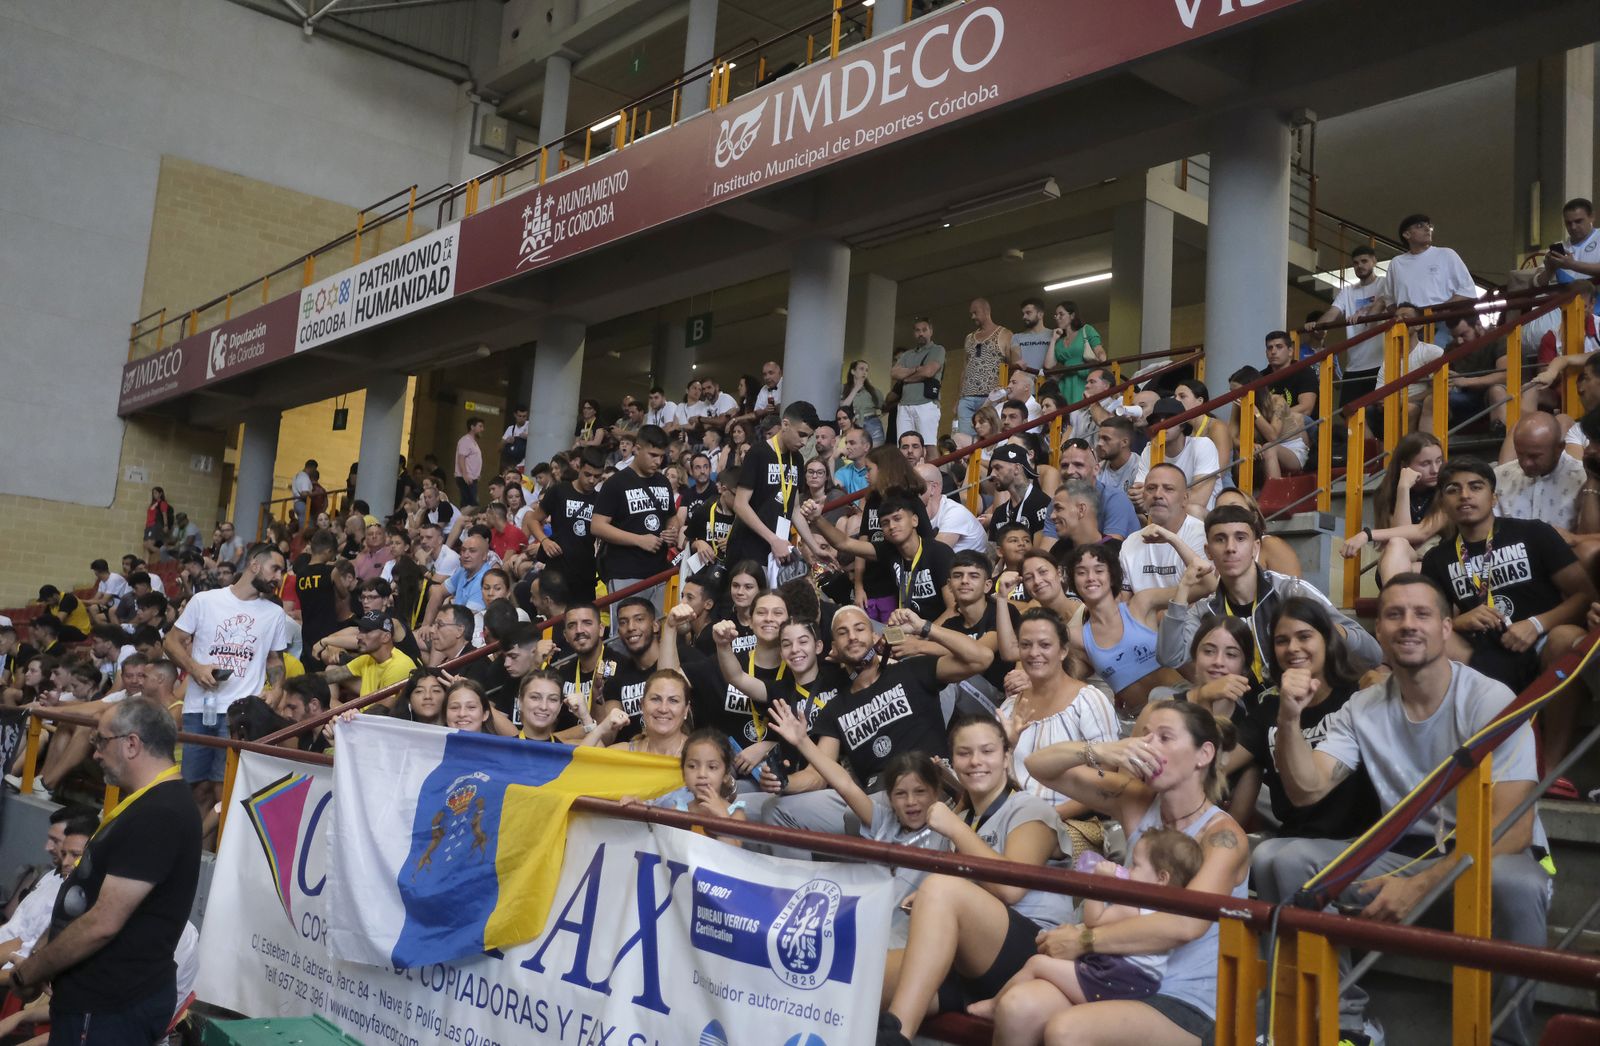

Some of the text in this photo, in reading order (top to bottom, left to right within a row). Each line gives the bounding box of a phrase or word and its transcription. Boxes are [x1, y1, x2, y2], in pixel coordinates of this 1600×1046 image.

[770, 5, 1005, 147] IMDECO
[712, 84, 999, 197] Instituto Municipal de Deportes Córdoba
[555, 168, 629, 217] AYUNTAMIENTO
[553, 201, 615, 243] DE CÓRDOBA
[357, 235, 454, 295] PATRIMONIO DE LA
[354, 265, 451, 325] HUMANIDAD
[229, 321, 267, 350] Diputación
[299, 311, 346, 345] CÓRDOBA
[692, 319, 704, 341] B
[134, 348, 183, 389] IMDECO
[227, 342, 265, 367] de Córdoba
[298, 574, 322, 591] CAT
[837, 682, 906, 733] KICKBOXING
[845, 698, 911, 748] CANARIAS
[696, 880, 733, 900] ISO 9001
[772, 881, 840, 938] BUREAU VERITAS
[695, 921, 733, 944] Certification
[697, 905, 760, 934] BUREAU VERITAS
[261, 937, 290, 964] Esteban
[357, 980, 369, 1001] 84
[379, 988, 403, 1015] Nave
[443, 1018, 463, 1043] Las
[278, 971, 295, 992] 957
[784, 970, 816, 986] 1828
[420, 962, 549, 1033] COPIADORAS
[556, 1004, 574, 1041] Y
[747, 992, 821, 1022] autorizado
